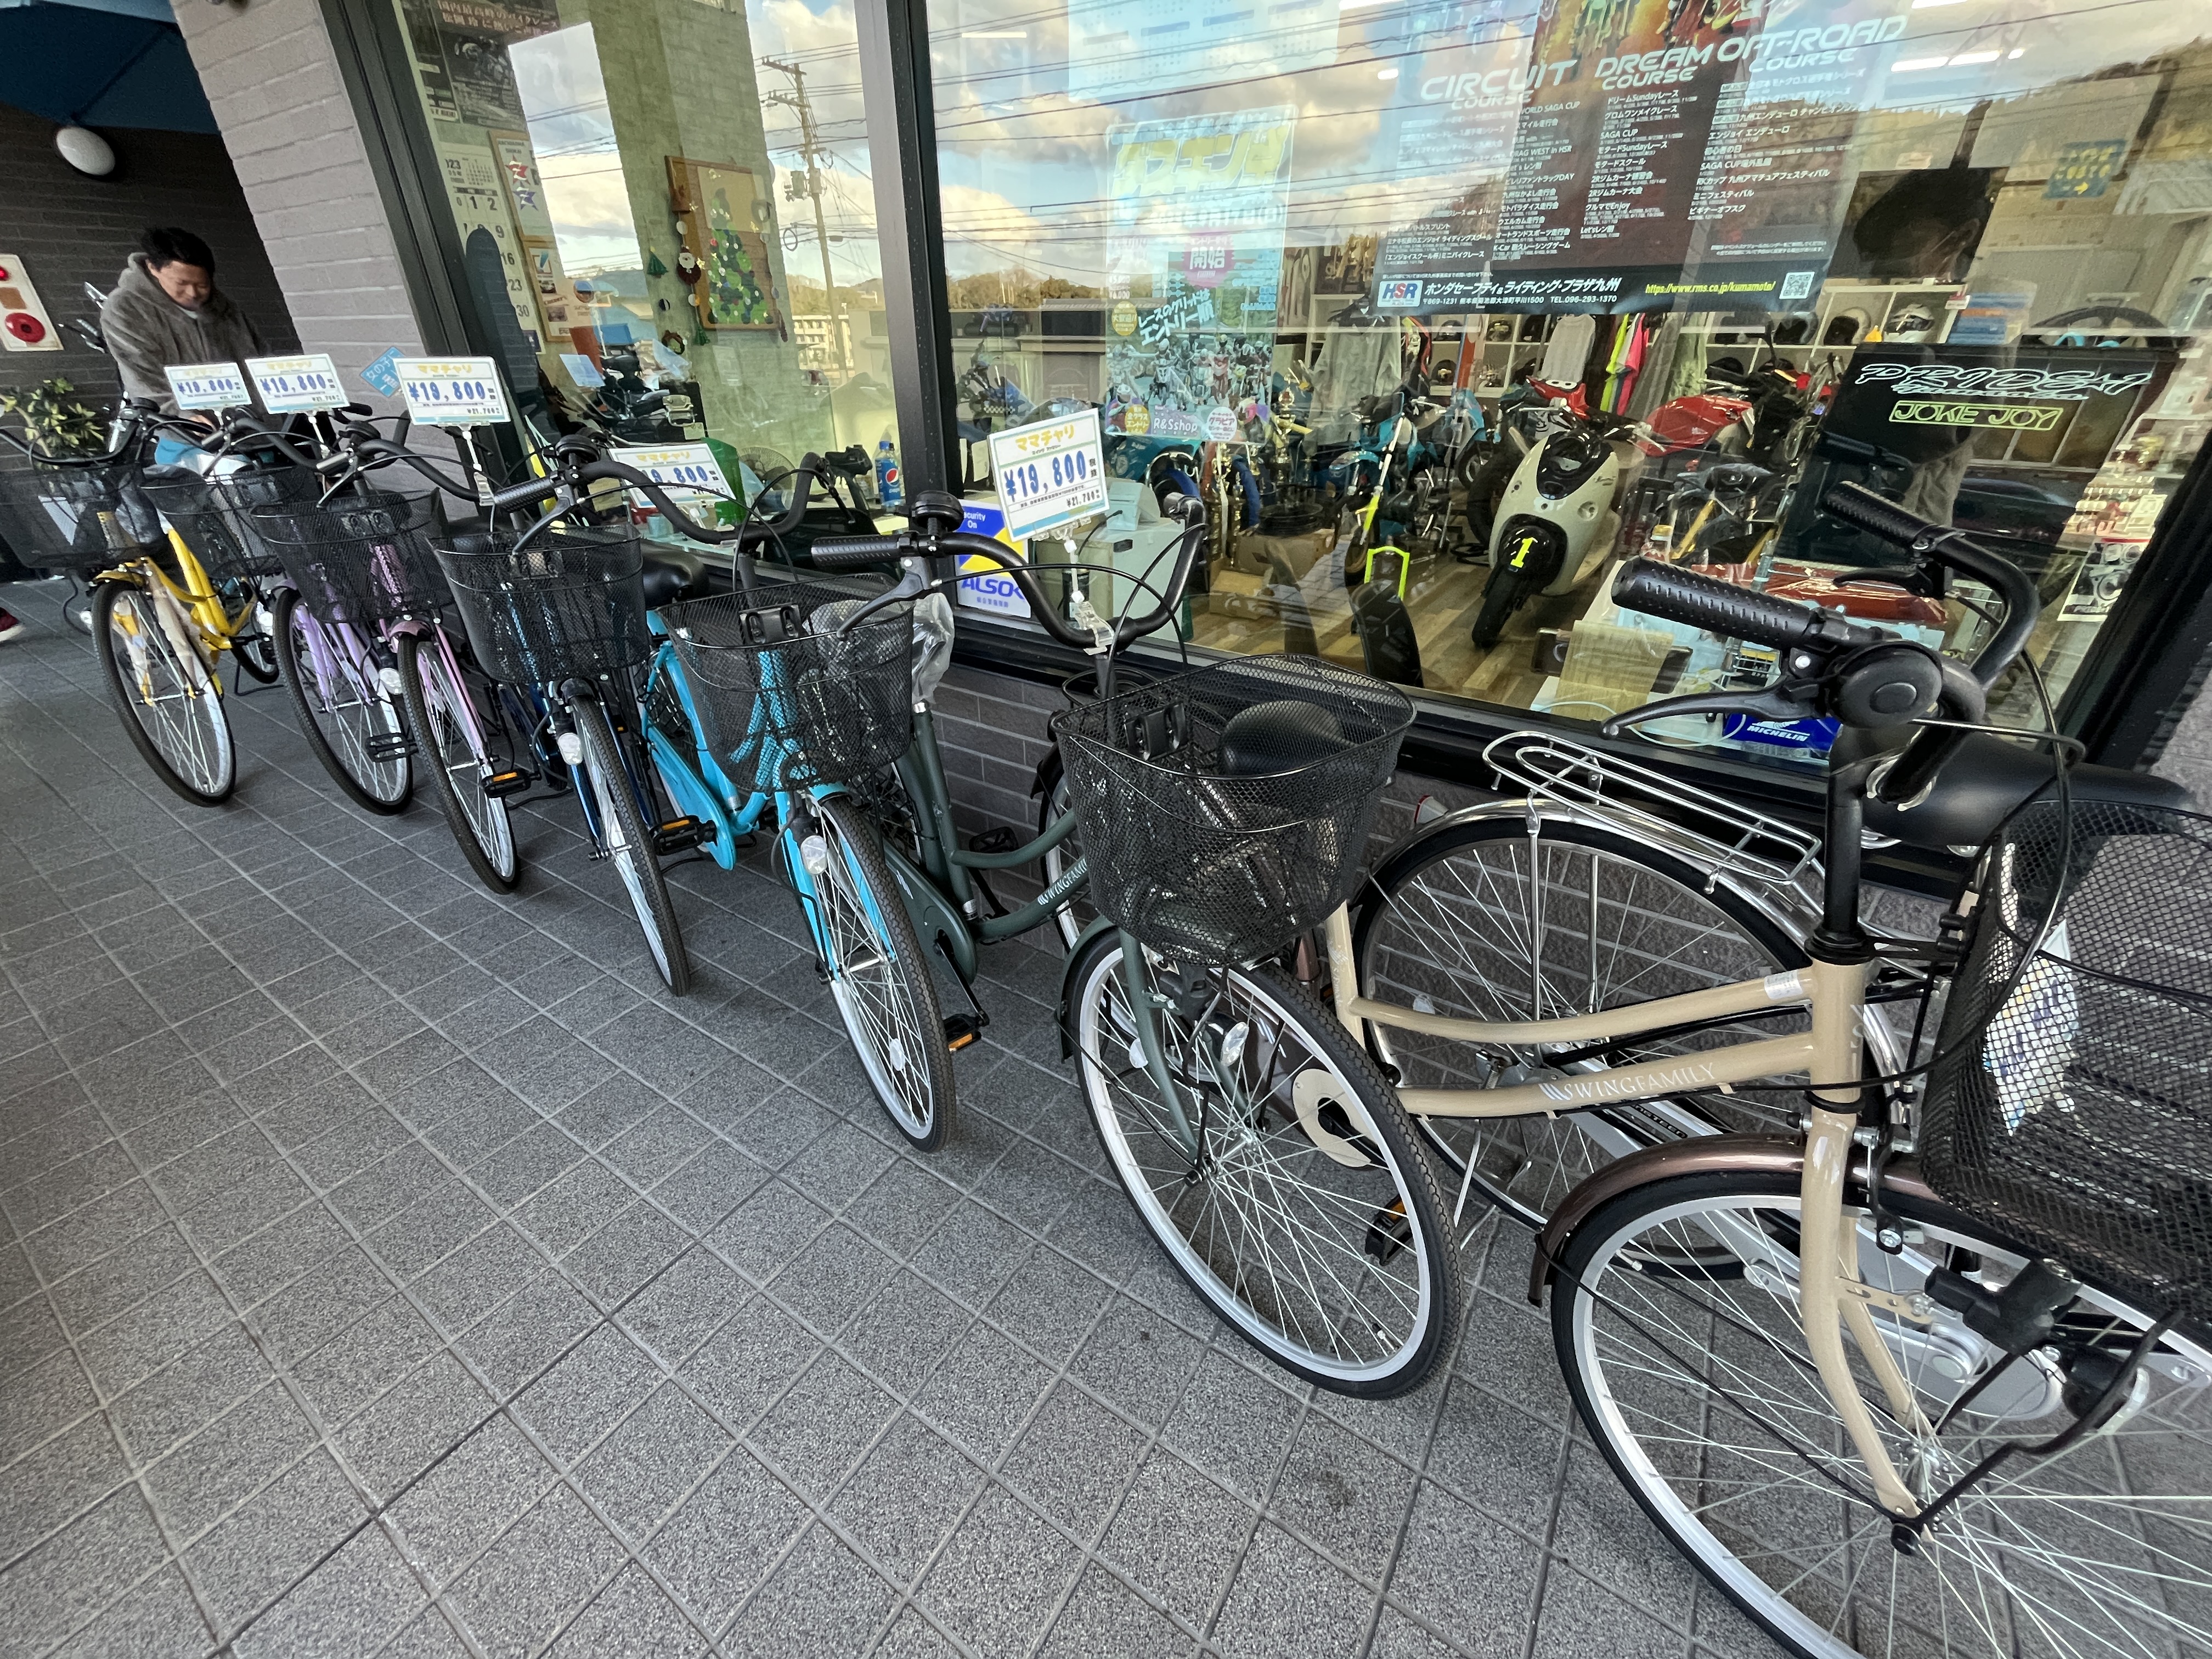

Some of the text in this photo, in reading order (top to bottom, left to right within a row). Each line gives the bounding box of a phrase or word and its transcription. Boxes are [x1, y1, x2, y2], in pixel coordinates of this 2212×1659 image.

[1594, 43, 1716, 78] DREAM
[1421, 60, 1577, 100] CIRCUIT
[1601, 66, 1698, 90] COURSE
[1451, 90, 1533, 110] COURSE
[1607, 89, 1679, 105] ドリームSundayレース
[1544, 103, 1564, 112] SAGA
[1565, 100, 1581, 110] CUP
[1600, 131, 1621, 139] SAGA
[1622, 128, 1639, 137] CUP
[1700, 162, 1723, 171] SAGA
[487, 198, 498, 211] 2
[495, 225, 505, 238] 9
[1189, 246, 1226, 270] 開始
[509, 279, 522, 291] 23
[1382, 283, 1418, 300] HSR
[1645, 281, 1776, 296] https://www.rms.co.jp/kumamoto/
[1550, 294, 1618, 305] TEL.096-293-1370
[516, 304, 529, 317] 30
[259, 374, 326, 394] ¥19,800
[407, 381, 486, 402] ¥19,800
[1894, 403, 2059, 428] JOKE JOY
[1153, 417, 1198, 432] R&Sshop
[1015, 424, 1075, 452] ママチャリ
[1004, 450, 1087, 503] ¥19,800
[964, 511, 986, 522] ecurity
[967, 520, 978, 529] On
[1747, 725, 1808, 742] MICHELIN
[1564, 1063, 1716, 1099] SWINGFAMILY
